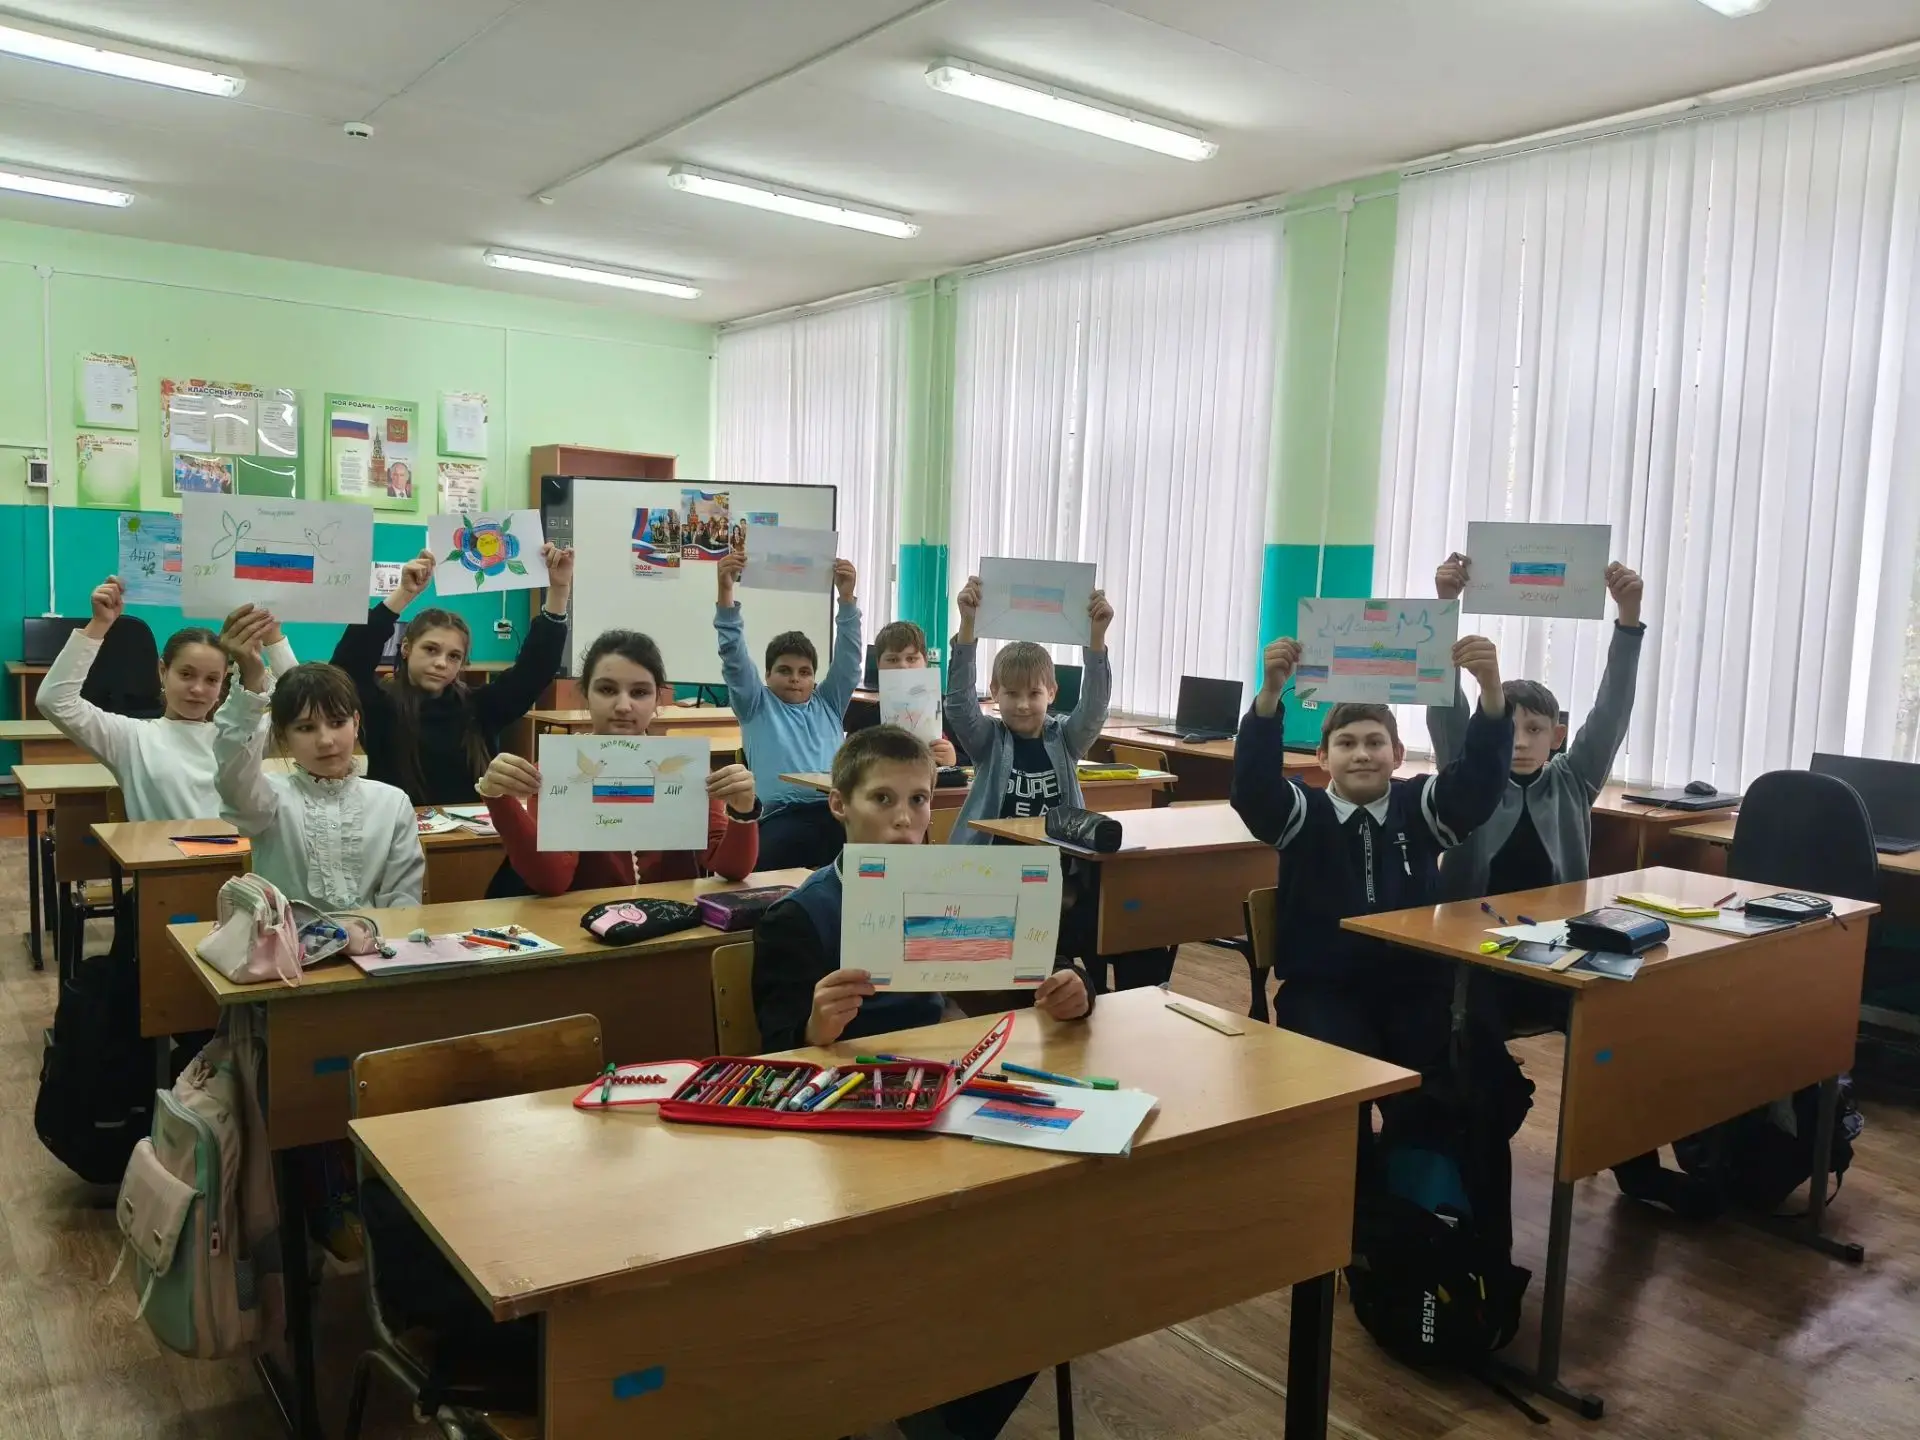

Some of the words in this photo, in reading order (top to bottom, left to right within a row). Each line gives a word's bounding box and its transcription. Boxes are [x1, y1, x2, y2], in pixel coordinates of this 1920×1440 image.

[188, 386, 233, 397] КЛАССНЫЙ
[235, 389, 264, 399] УГОЛОК
[332, 399, 347, 407] МОЯ
[348, 401, 376, 409] РОДИНА
[385, 405, 413, 413] РОССИЯ
[1007, 775, 1061, 799] UPE
[1422, 1290, 1436, 1344] ACROSS
